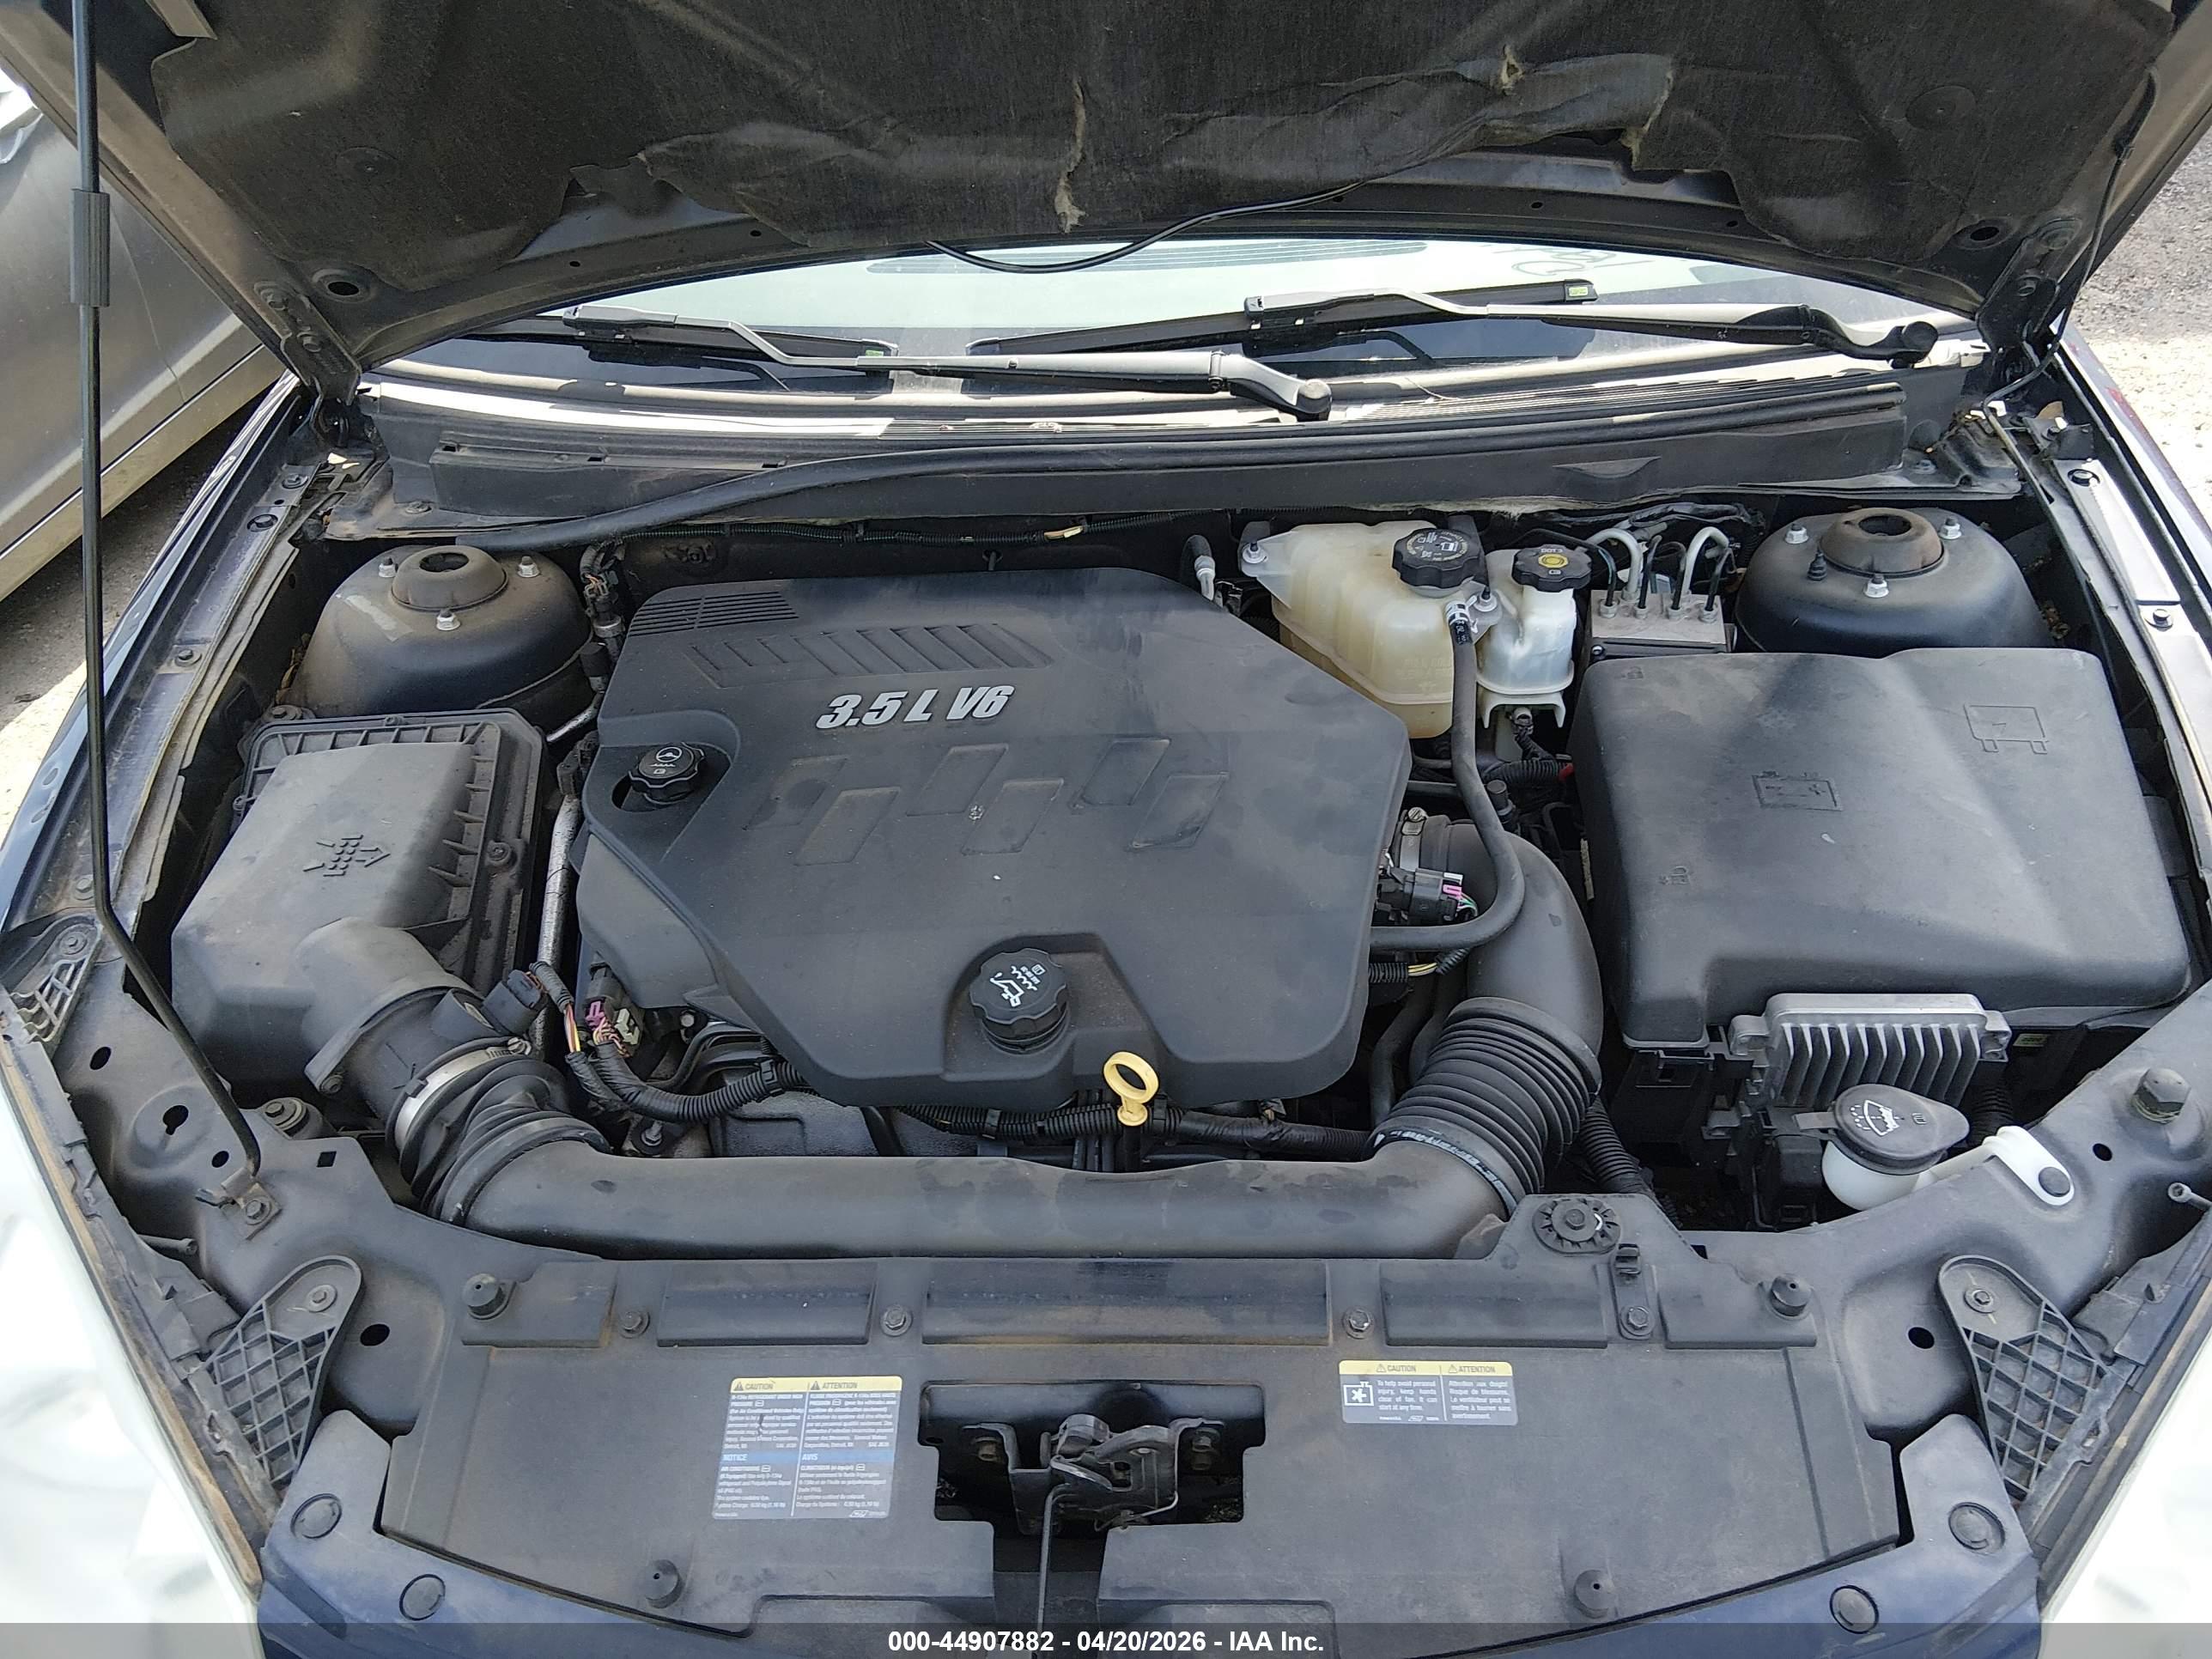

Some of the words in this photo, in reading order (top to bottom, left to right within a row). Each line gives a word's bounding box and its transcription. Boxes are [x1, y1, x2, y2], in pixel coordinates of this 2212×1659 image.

[816, 690, 908, 729] 3.5
[902, 689, 939, 722] L
[945, 685, 1015, 720] V6
